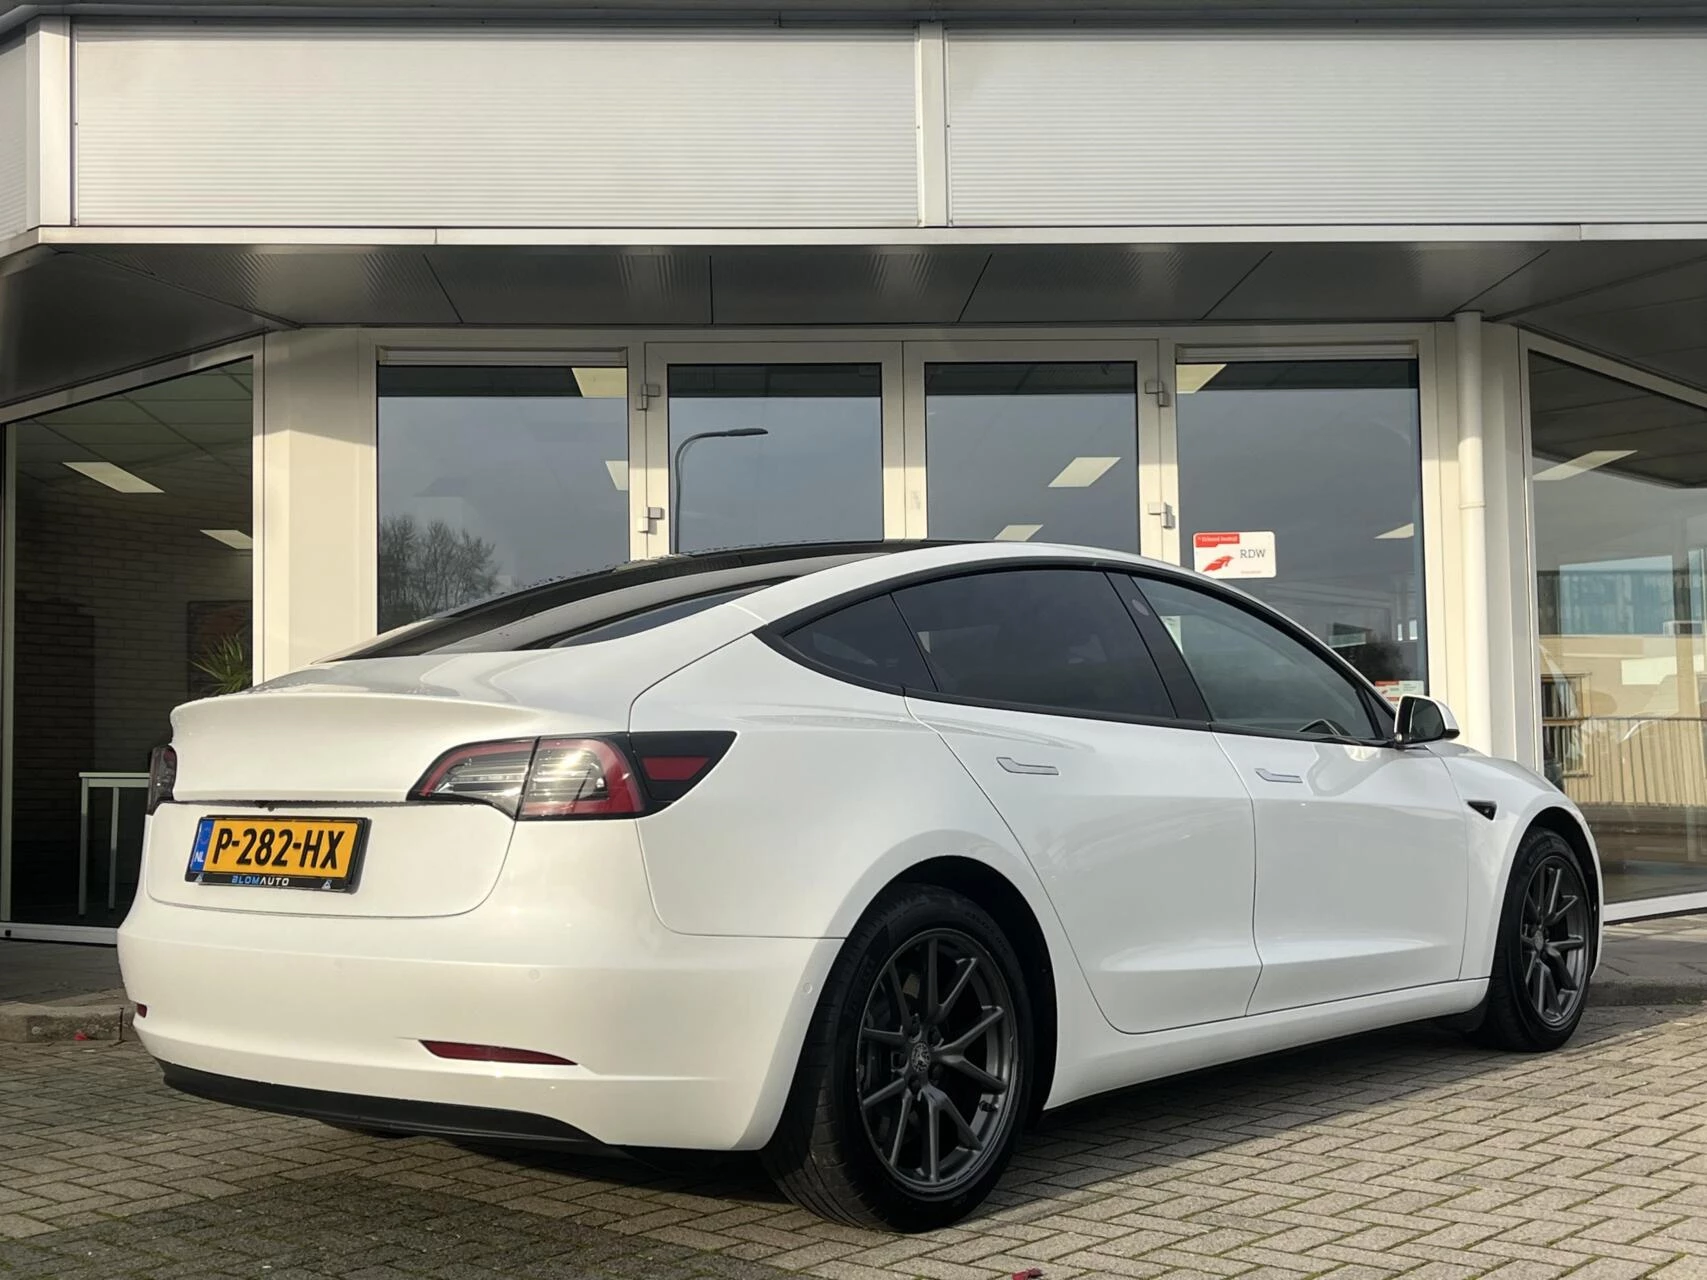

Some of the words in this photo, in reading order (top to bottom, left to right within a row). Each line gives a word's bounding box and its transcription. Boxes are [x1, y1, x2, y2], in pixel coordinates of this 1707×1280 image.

[1240, 549, 1266, 559] RDW
[212, 828, 345, 869] P-282-HX
[194, 851, 204, 863] NL
[231, 875, 290, 886] BLOMAUTO
